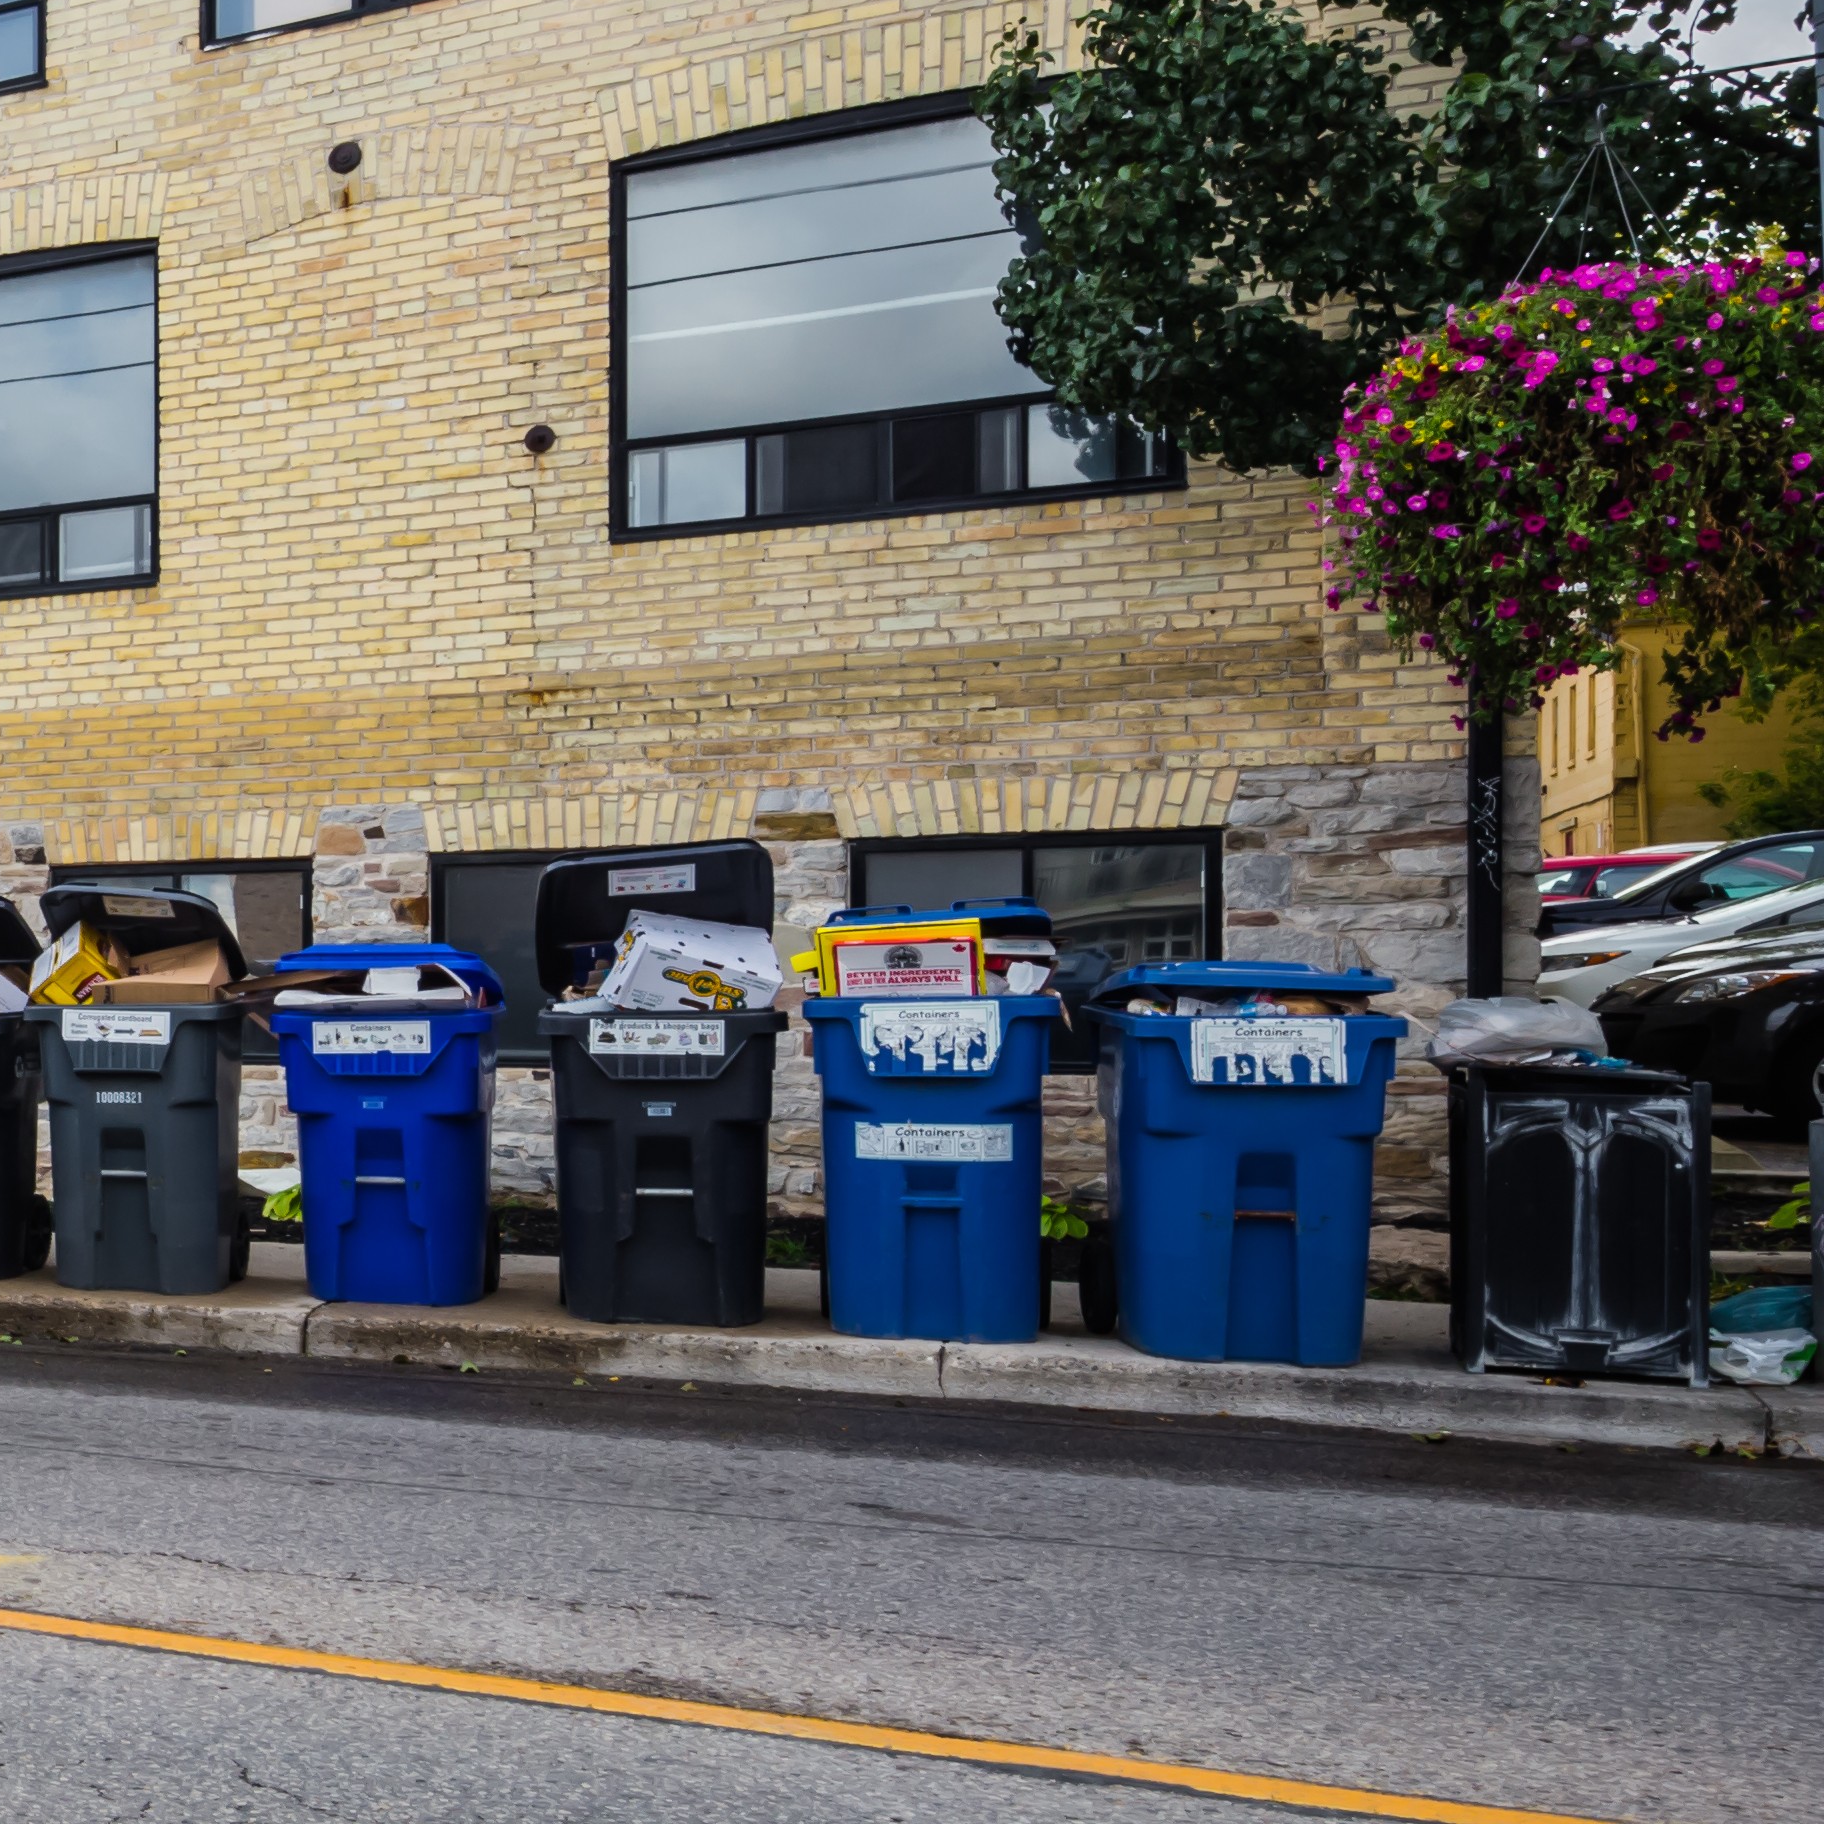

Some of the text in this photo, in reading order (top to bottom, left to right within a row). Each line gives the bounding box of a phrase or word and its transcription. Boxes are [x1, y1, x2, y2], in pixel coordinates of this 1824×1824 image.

[846, 970, 887, 979] BETTER
[887, 975, 932, 984] ALWAYS
[77, 1013, 153, 1023] Corrugated cardboard
[898, 1009, 961, 1020] Containers
[350, 1023, 393, 1032] Containers
[663, 1022, 699, 1032] shopping
[700, 1021, 720, 1032] bags
[1235, 1027, 1304, 1038] Containers
[895, 1126, 966, 1138] Containers
